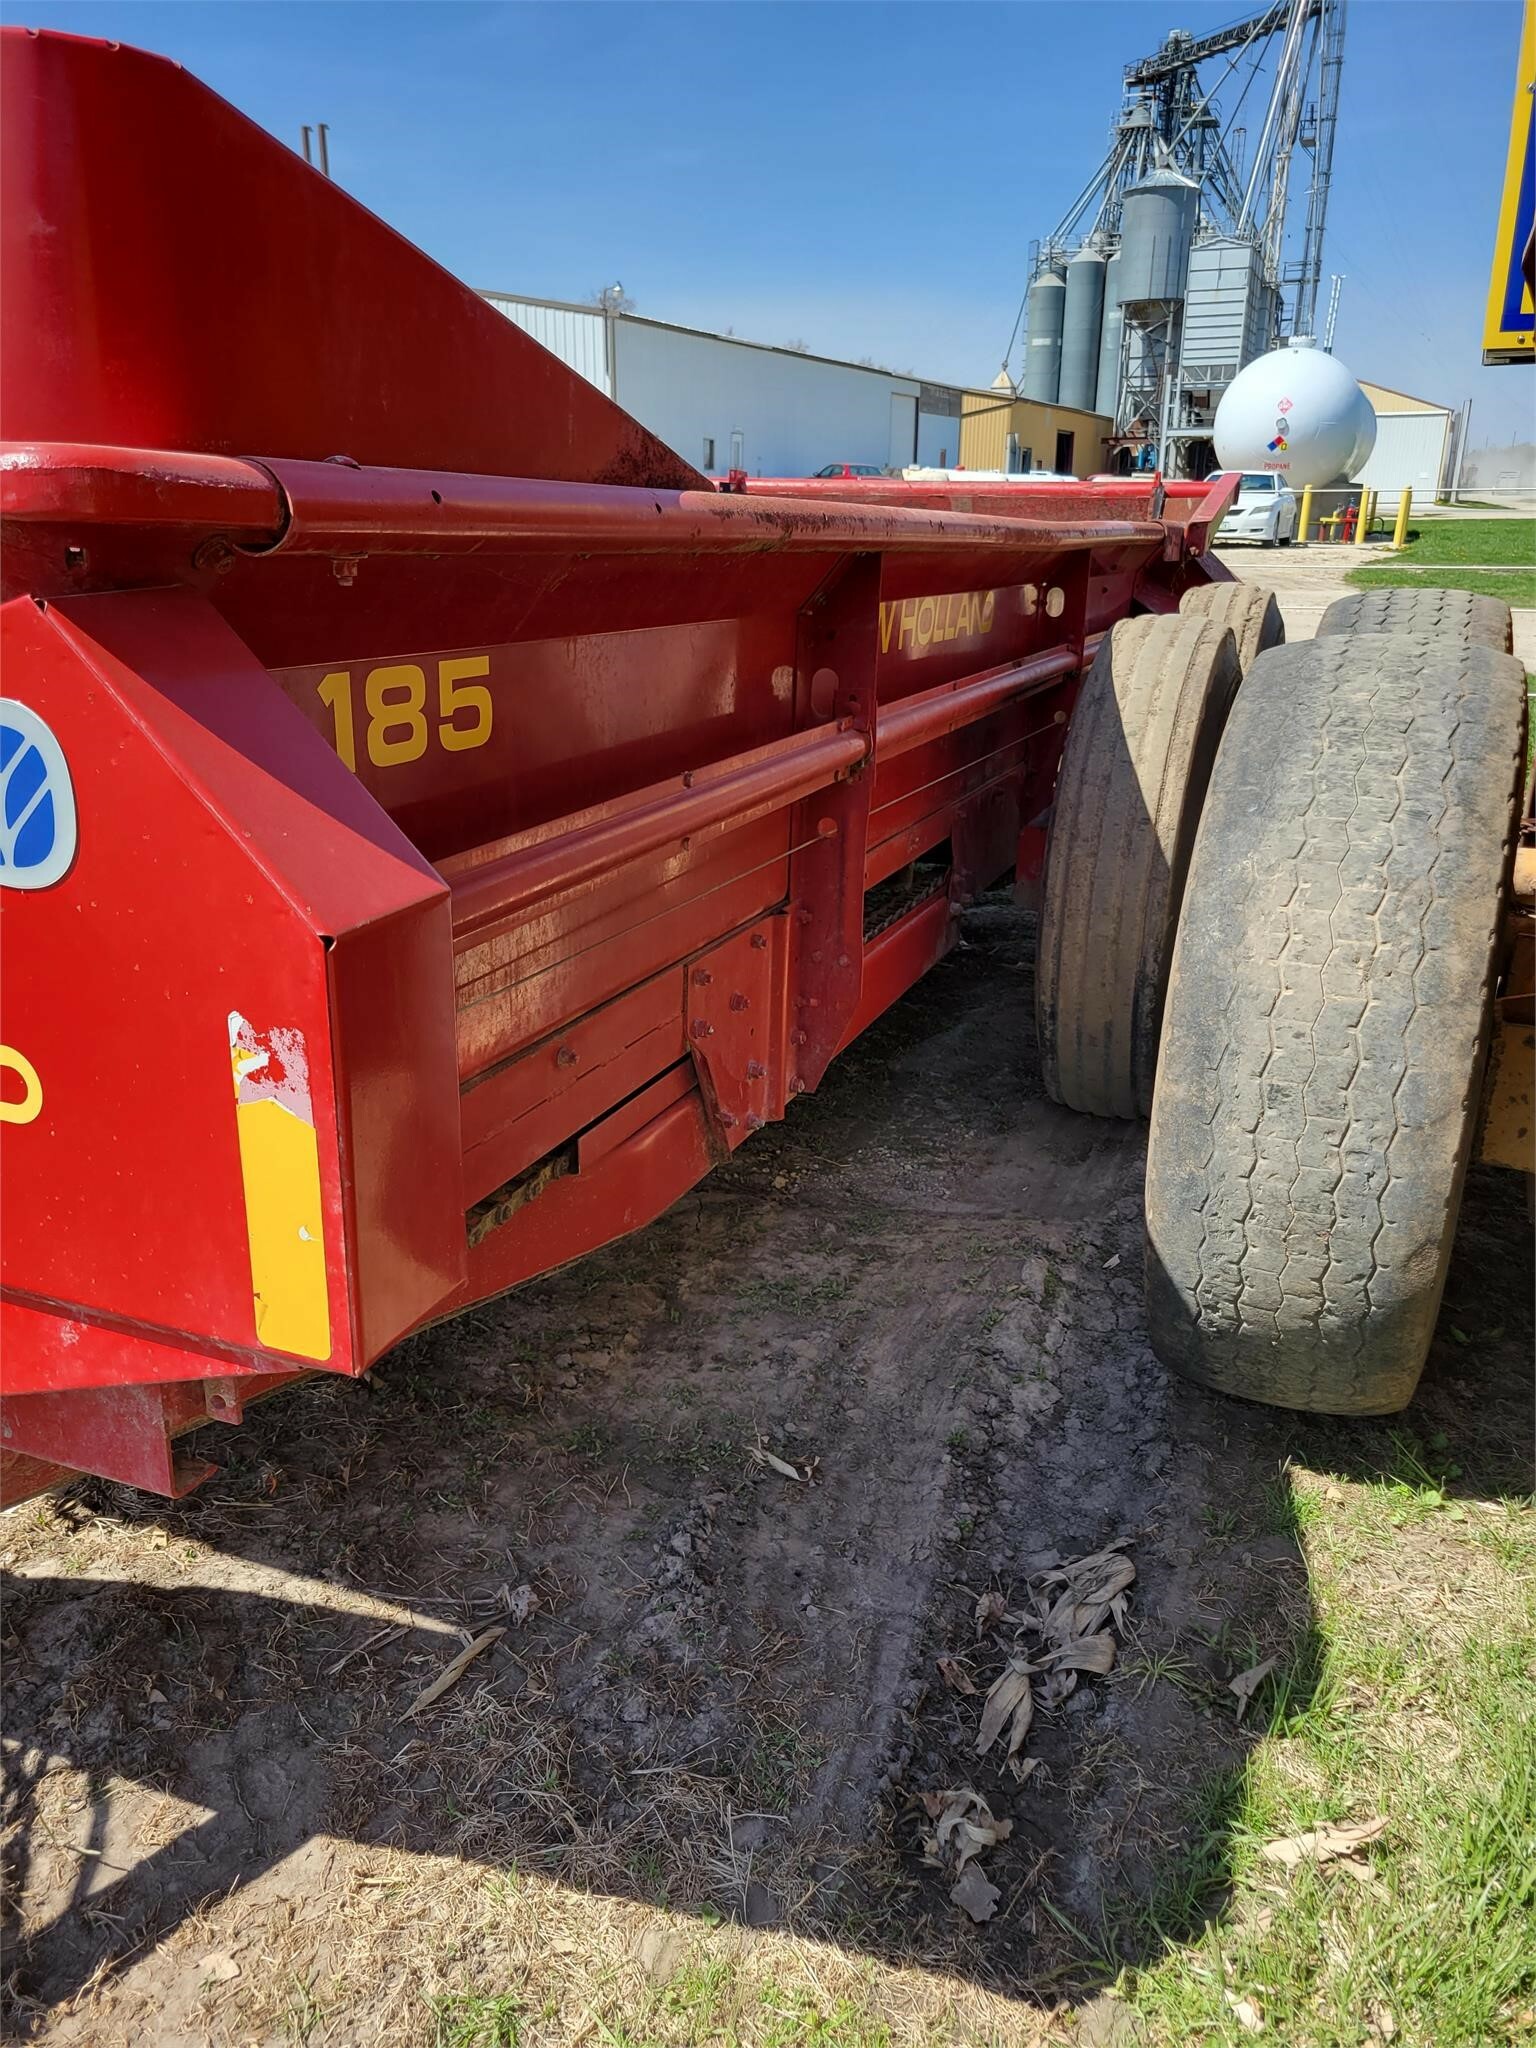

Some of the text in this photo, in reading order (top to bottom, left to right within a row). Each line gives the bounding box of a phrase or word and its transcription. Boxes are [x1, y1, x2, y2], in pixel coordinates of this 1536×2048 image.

[1264, 462, 1291, 471] PROPANE
[898, 591, 994, 651] HOLLAND
[316, 655, 493, 774] 185
